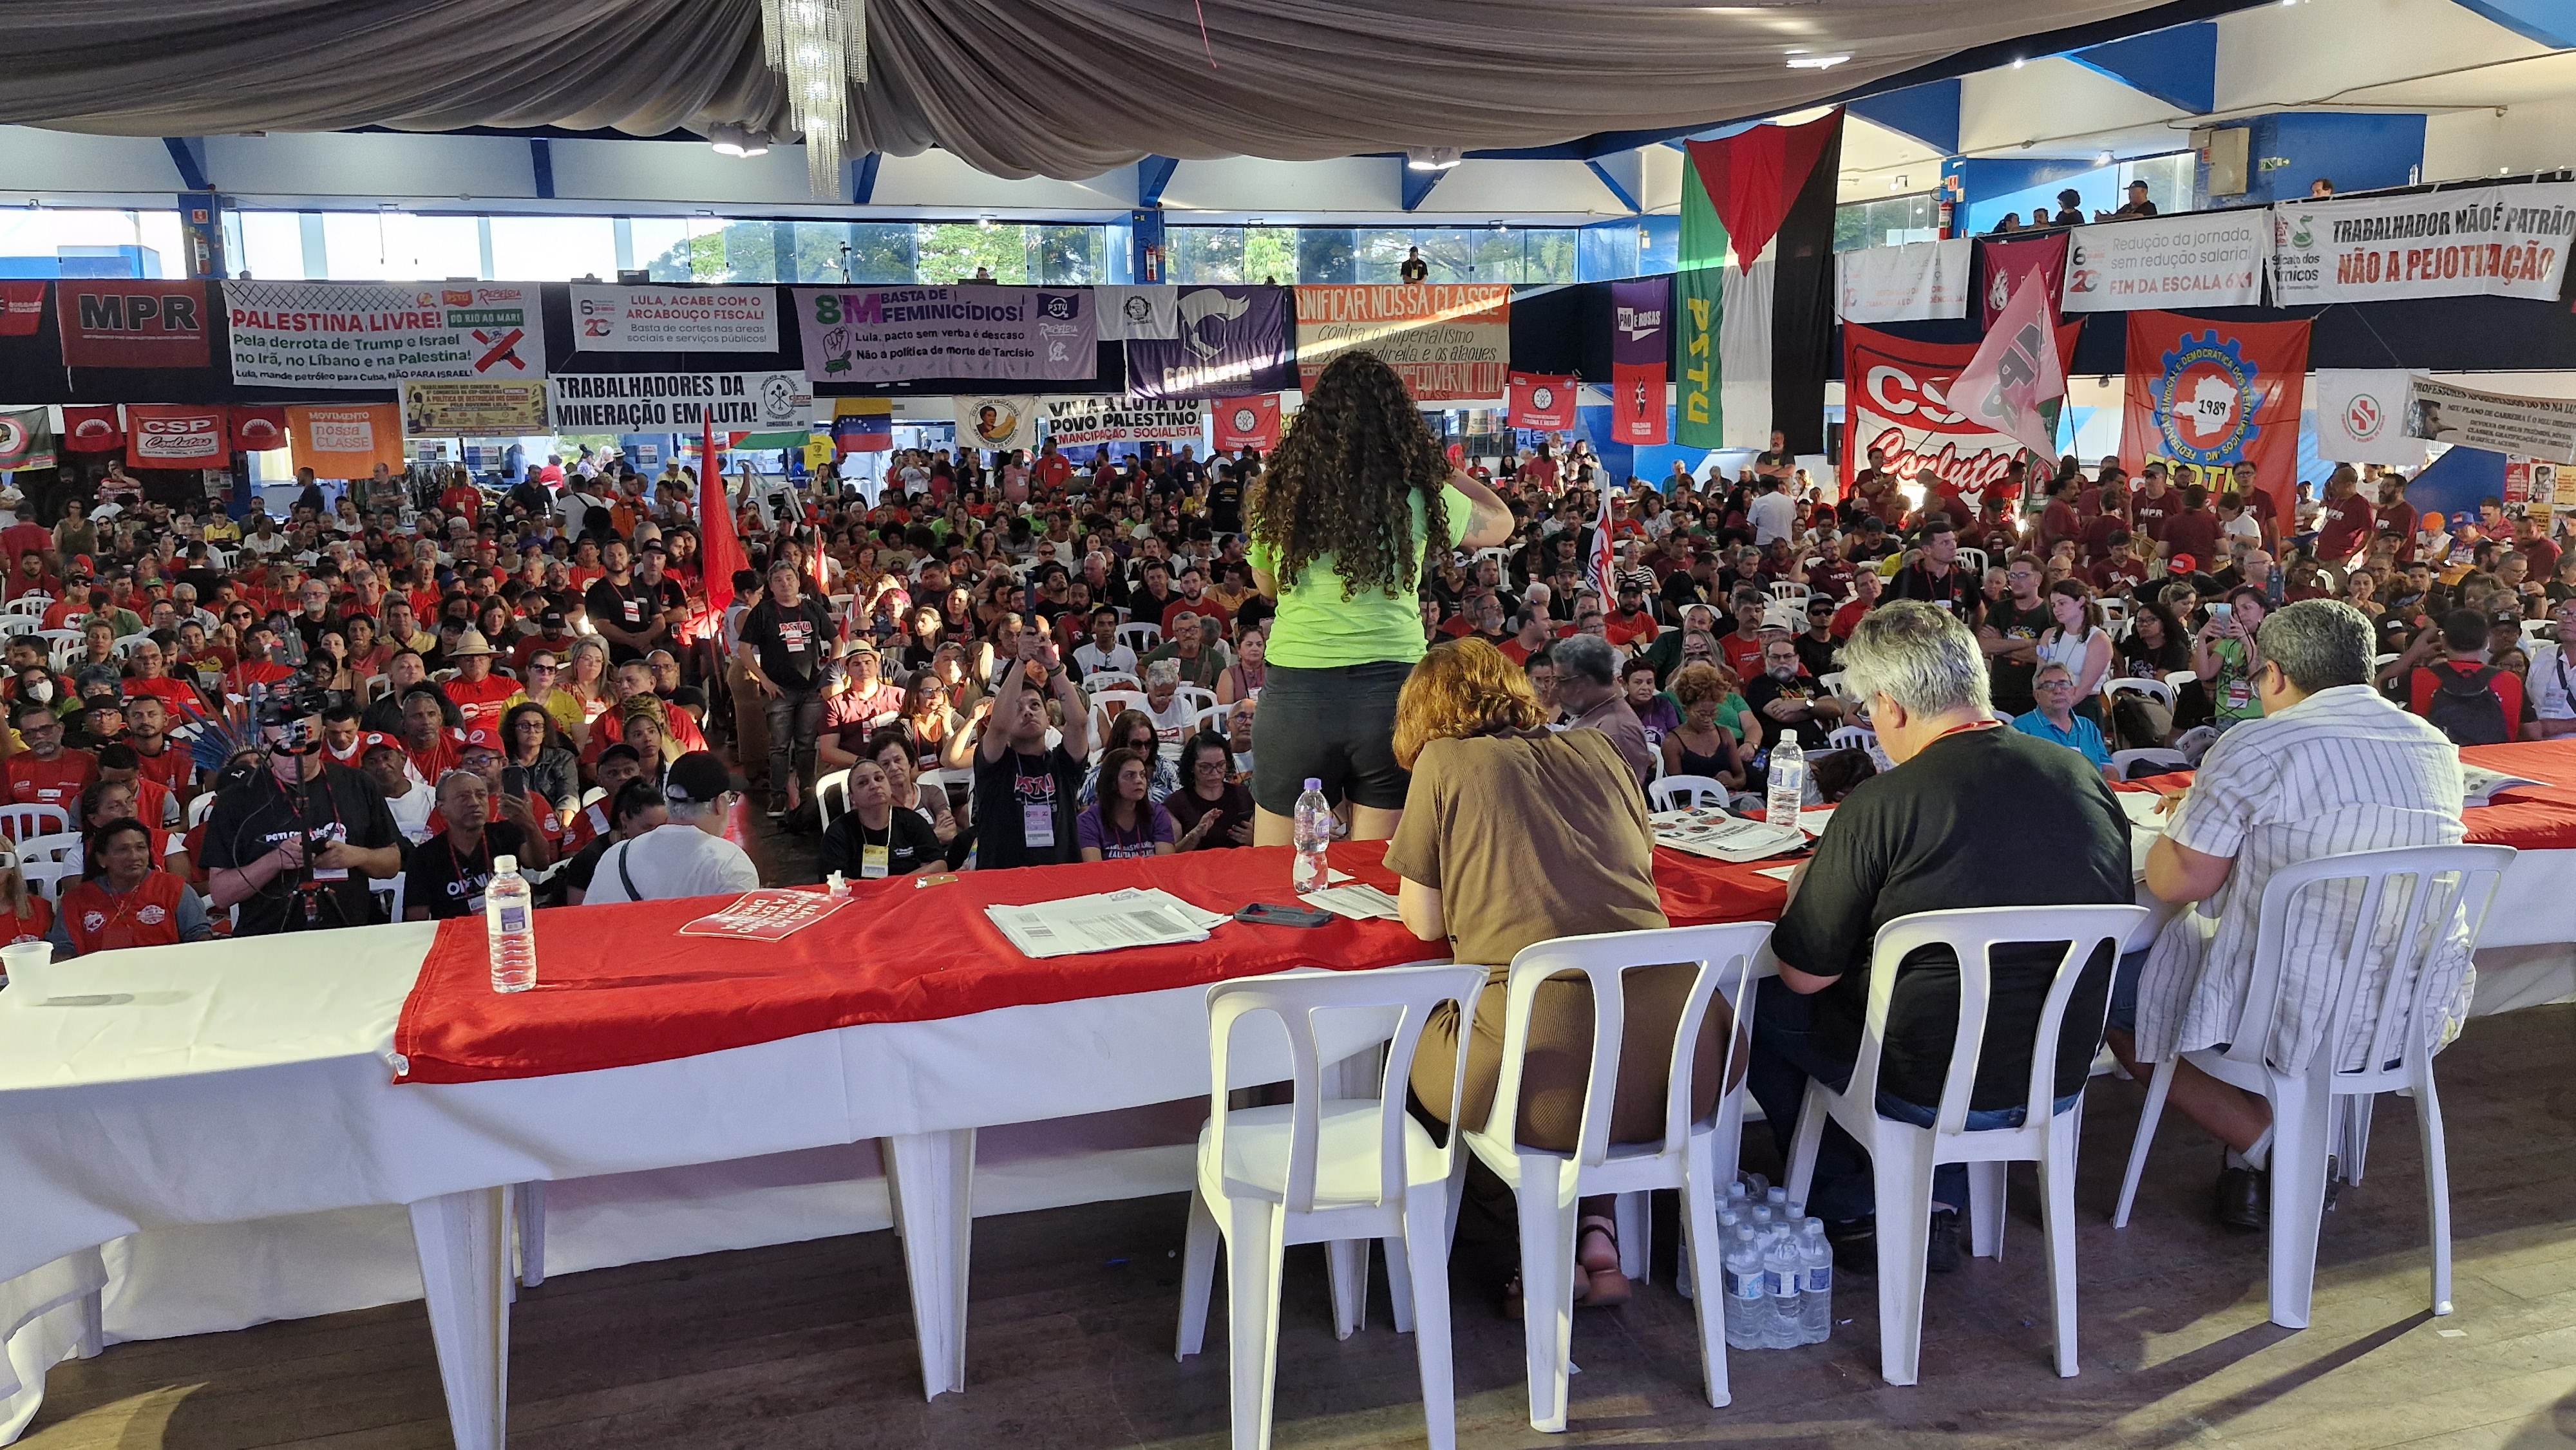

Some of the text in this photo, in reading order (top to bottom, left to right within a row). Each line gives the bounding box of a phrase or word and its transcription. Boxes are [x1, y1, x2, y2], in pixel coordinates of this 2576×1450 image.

[2333, 211, 2450, 243] TRABALHADOR
[2505, 205, 2576, 237] PATRÃO
[2112, 227, 2253, 252] Redução da jornada,
[2072, 246, 2087, 266] 6
[2111, 246, 2252, 269] sem redução salarial
[2302, 253, 2320, 265] dos
[2336, 240, 2555, 285] NÃO A PEJOTIAÇÃO
[2109, 271, 2253, 295] FIM DA ESCALA 6X1
[631, 296, 761, 306] LULA, ACABE COM O
[881, 290, 926, 303] BASTA
[928, 289, 948, 301] DE
[1296, 285, 1500, 321] UNIFICAR NOSSA CLASSE
[79, 294, 200, 331] MPR
[580, 299, 594, 315] 6
[627, 309, 764, 322] ARCABOUÇO FISCAL!
[882, 301, 1024, 323] FEMINICÍDIOS!
[1048, 303, 1068, 312] PSTU
[232, 309, 442, 332] PALESTINA LIVRE!
[464, 314, 479, 323] RIO
[482, 314, 494, 323] AO
[1619, 310, 1661, 328] PÃO E ROSAS
[631, 323, 661, 332] Basta
[663, 324, 676, 332] de
[736, 323, 765, 333] áreas
[885, 329, 1025, 343] pacto sem verba é descaso
[1372, 328, 1381, 341] o
[233, 334, 460, 352] Pela derrota de Trump e Israel
[676, 334, 719, 344] serviços
[721, 334, 767, 343] públicos!
[235, 350, 471, 367] no Irã, no Líbano e na Palestina!
[857, 349, 878, 360] Não
[890, 346, 928, 360] política
[931, 347, 944, 356] de
[946, 346, 975, 356] morte
[978, 347, 991, 357] de
[993, 347, 1035, 358] Tarcísio
[1377, 343, 1418, 362] direita
[1421, 348, 1430, 361] e
[1435, 348, 1449, 361] os
[1687, 297, 1710, 424] PSTU
[236, 369, 258, 379] Lula,
[260, 371, 292, 380] mande
[294, 370, 336, 382] petróleo
[337, 374, 358, 382] para
[360, 372, 386, 382] Cuba,
[388, 369, 408, 379] NÃO
[437, 370, 473, 379] ISRAEL!
[1416, 364, 1506, 393] GOVERNO LULA
[2175, 362, 2183, 371] E
[2232, 366, 2246, 386] DOS
[556, 375, 746, 399] TRABALHADORES DA
[1419, 390, 1452, 401] CLASSE
[308, 411, 370, 420] MOVIMENTO
[556, 399, 667, 432] MINERAÇÃO
[672, 402, 702, 424] EM
[708, 402, 758, 424] LUTA!
[1048, 397, 1198, 417] VIVA A LUTA DO
[2197, 399, 2226, 416] 1989
[2461, 406, 2484, 415] PLANO
[2551, 402, 2562, 412] NA
[143, 419, 212, 433] CSP
[316, 425, 359, 435] nossa
[1050, 410, 1202, 433] POVO PALESTINO!
[1133, 426, 1202, 438] SOCIALISTA
[146, 435, 213, 449] Conlutas
[317, 437, 370, 448] CLASSE
[2139, 507, 2163, 518] MPR
[1014, 773, 1056, 796] PSTU
[771, 904, 821, 928] NÃO AO
